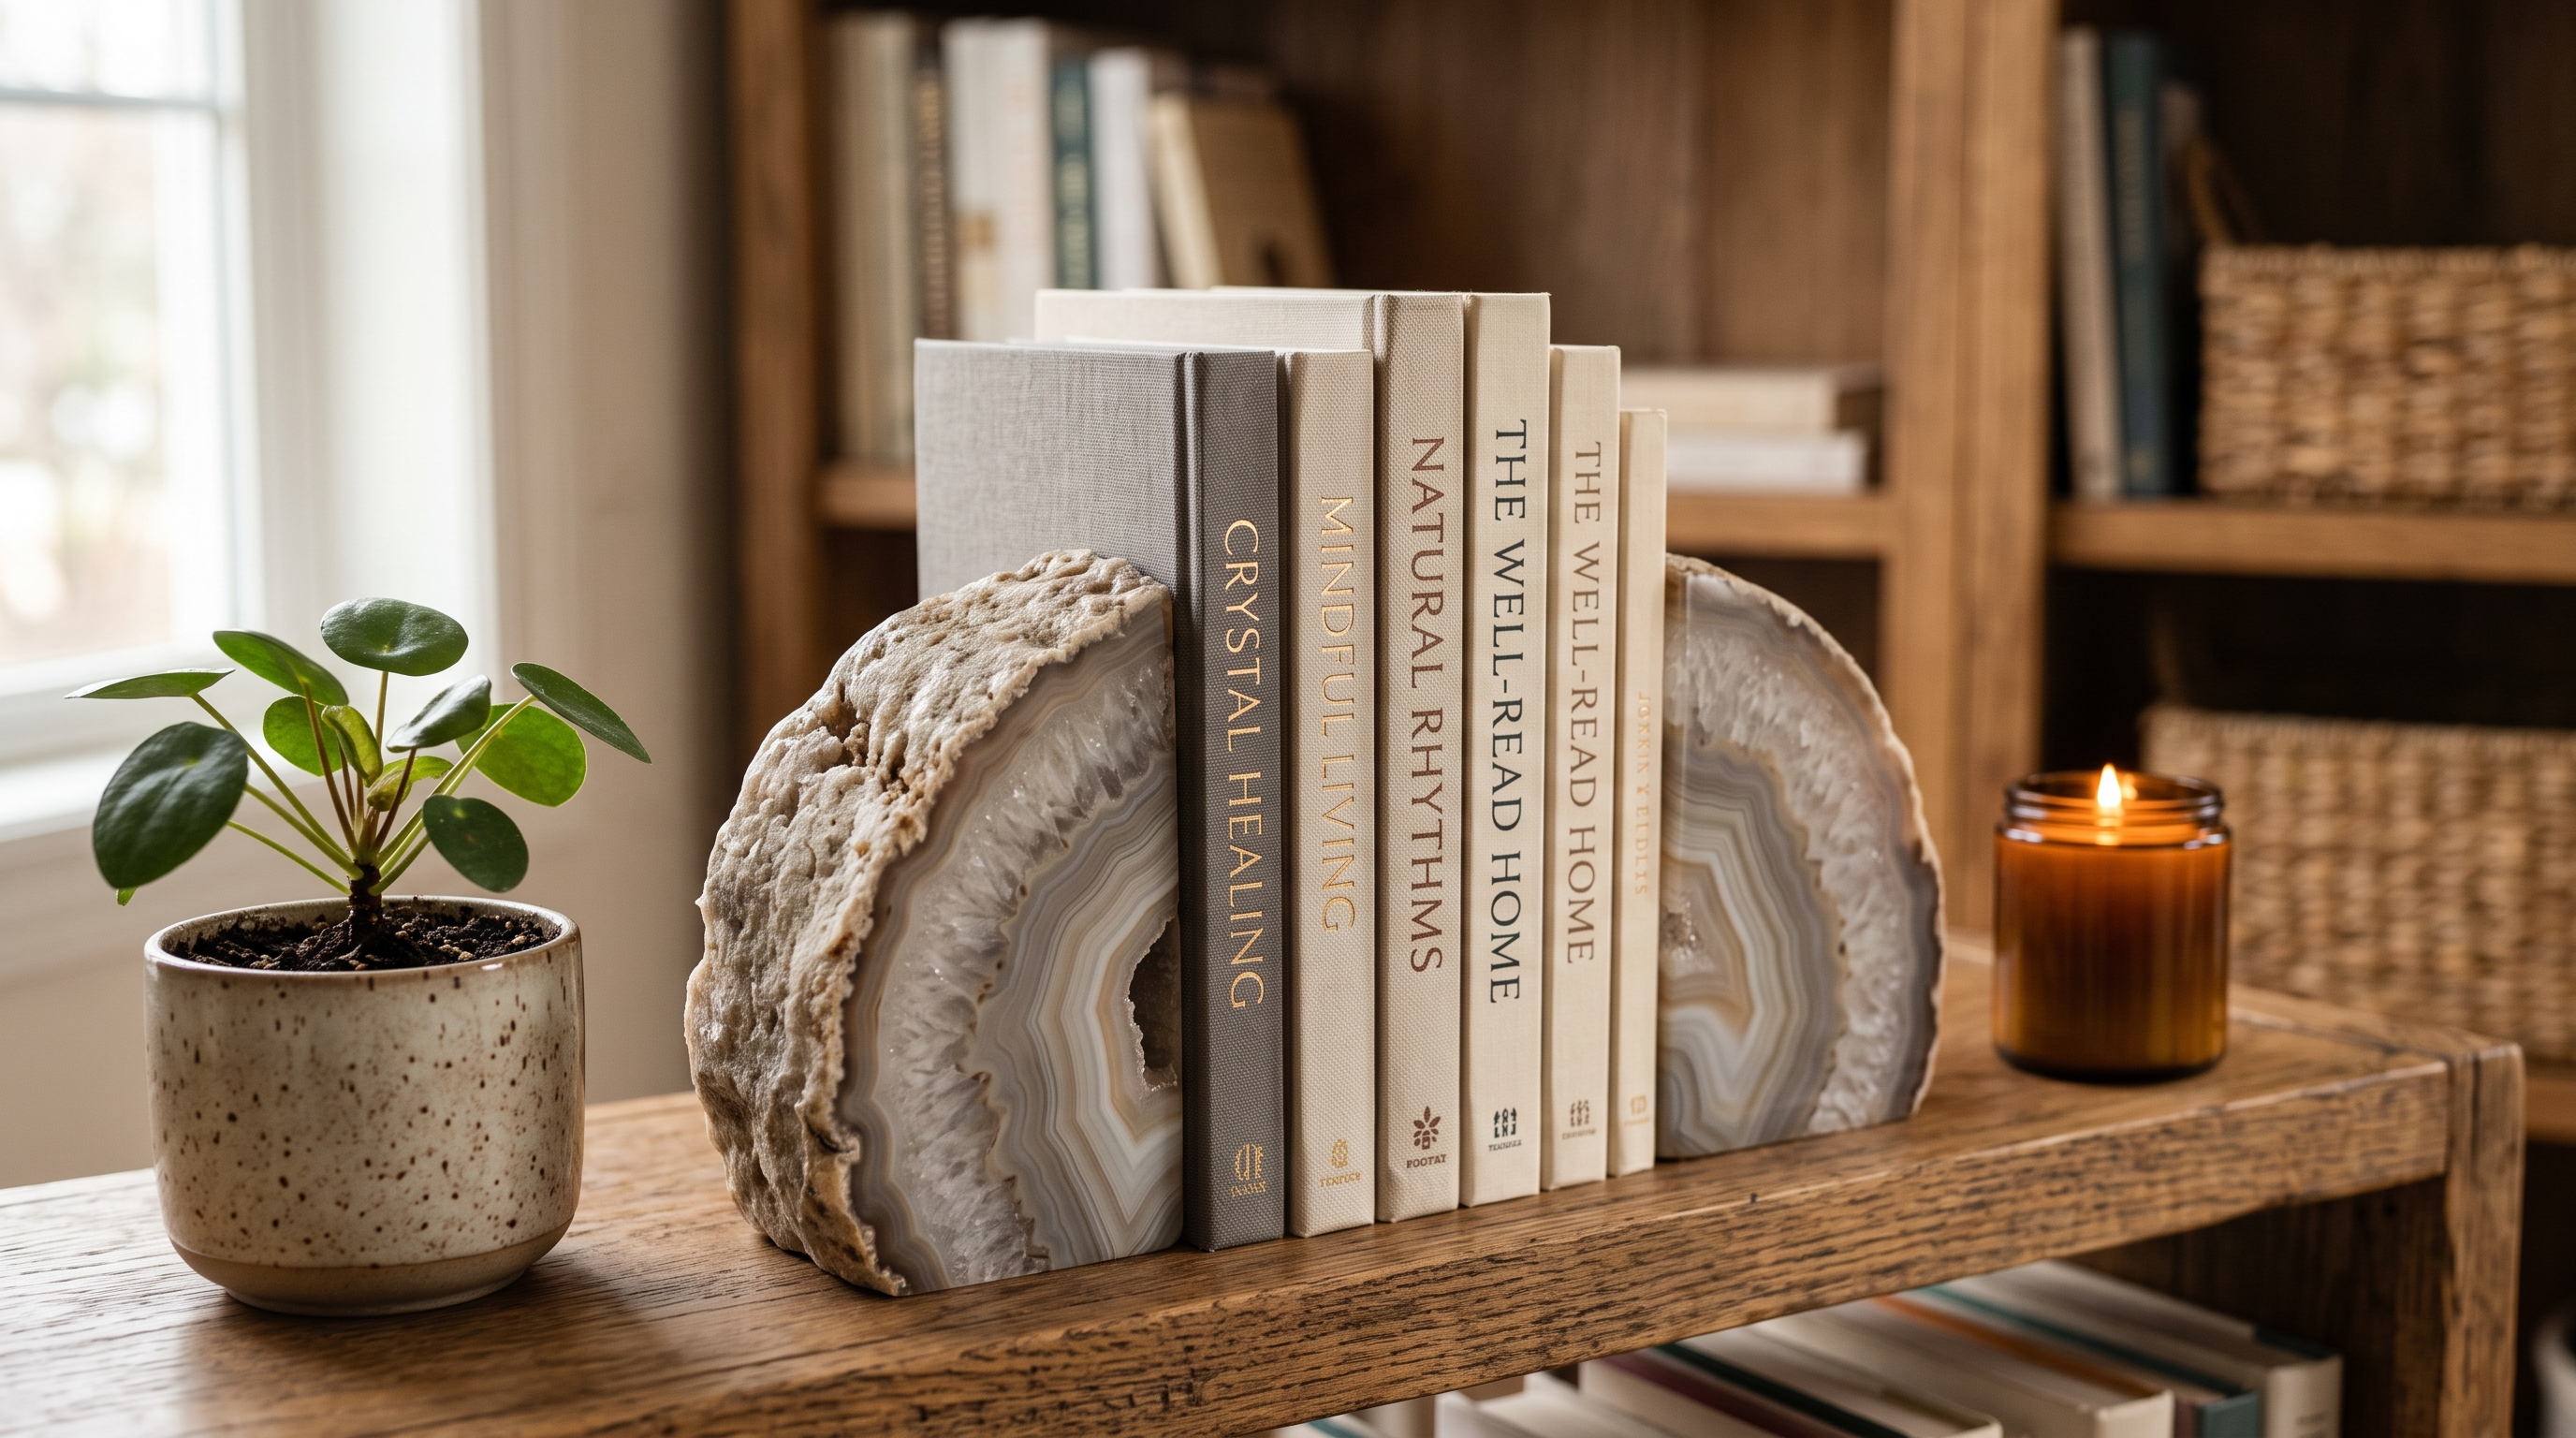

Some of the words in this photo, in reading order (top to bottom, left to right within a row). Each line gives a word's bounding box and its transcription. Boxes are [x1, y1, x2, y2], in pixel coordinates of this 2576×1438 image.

[1411, 436, 1445, 688] NATURAL
[1495, 418, 1527, 521] THE
[1574, 442, 1601, 524] THE
[1224, 520, 1262, 752] CRYSTAL
[1320, 496, 1354, 738] MINDFUL
[1491, 538, 1526, 832] WELL-READ
[1569, 541, 1600, 808] WELL-READ
[1228, 771, 1265, 1009] HEALING
[1321, 755, 1355, 932] LIVING
[1410, 709, 1443, 974] RHYTHMS
[1489, 850, 1522, 1005] HOME
[1567, 825, 1596, 964] HOME
